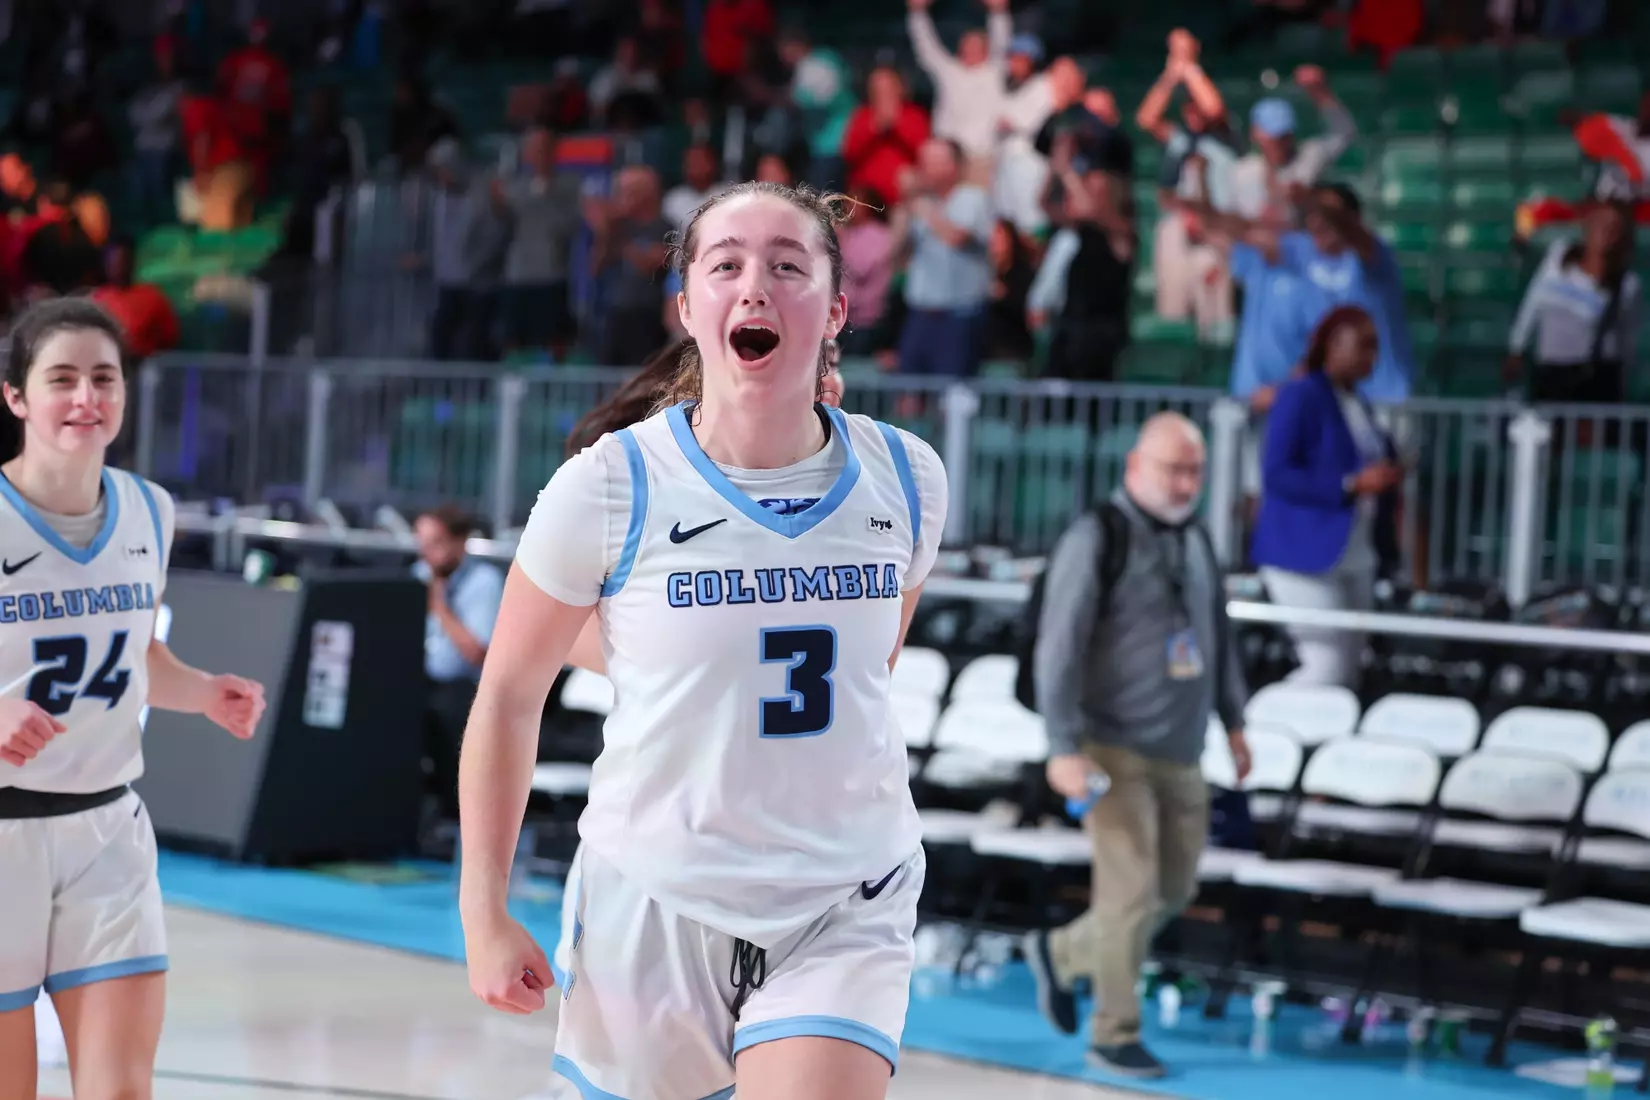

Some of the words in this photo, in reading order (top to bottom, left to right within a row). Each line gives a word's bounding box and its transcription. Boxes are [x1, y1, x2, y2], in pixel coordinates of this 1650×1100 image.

[869, 516, 885, 531] Ivy
[667, 563, 898, 608] COLUMBIA
[25, 628, 132, 716] 24
[759, 623, 838, 739] 3
